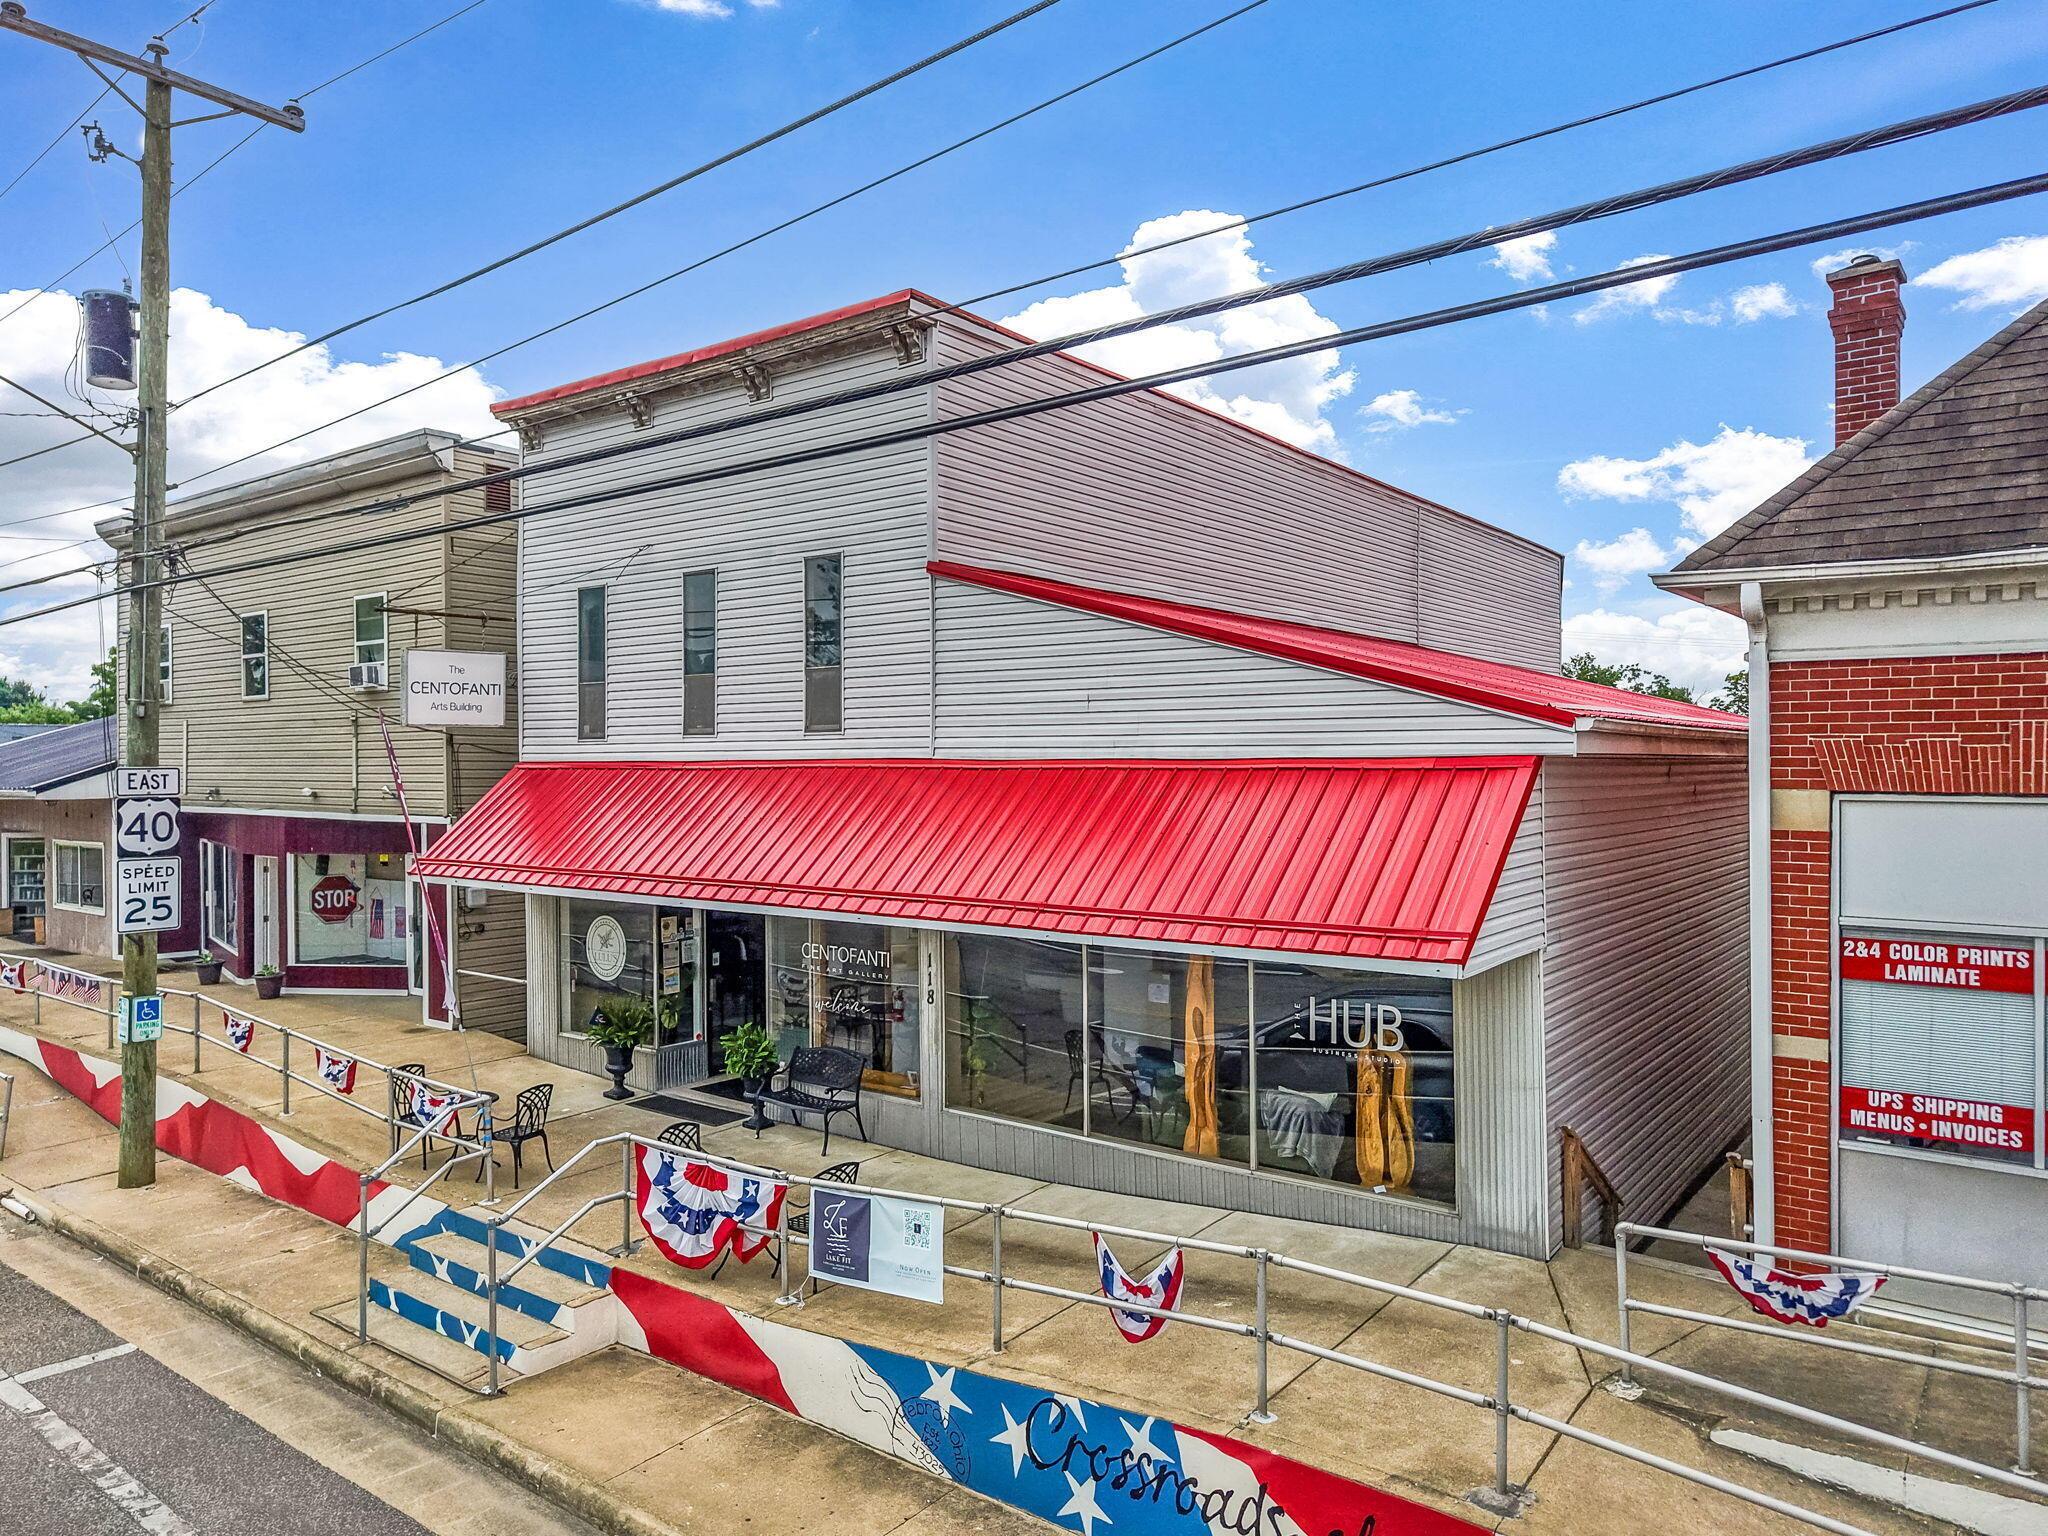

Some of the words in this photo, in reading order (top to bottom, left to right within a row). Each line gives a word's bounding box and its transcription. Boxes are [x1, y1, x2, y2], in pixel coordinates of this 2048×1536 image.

[449, 665, 466, 675] The
[410, 681, 501, 696] CENTOFANTI
[430, 702, 448, 711] Arts
[449, 702, 483, 713] Building
[127, 773, 169, 790] EAST
[124, 811, 174, 843] 40
[122, 866, 175, 879] SPEED
[128, 881, 169, 893] LIMIT
[314, 889, 356, 909] STOP
[124, 895, 173, 924] 25
[801, 942, 890, 968] CENTOFANTI
[1843, 940, 1881, 959] 2&4
[1889, 943, 1949, 963] COLOR
[1957, 948, 2030, 969] PRINTS
[801, 963, 821, 972] FINE
[826, 967, 843, 975] ART
[848, 969, 890, 980] GALLERY
[1884, 963, 1981, 987] LAMINATE
[815, 989, 871, 1014] welcome
[135, 1021, 160, 1030] PARKING
[1309, 996, 1404, 1052] HUB
[1312, 1047, 1358, 1059] BUSINESS
[1364, 1055, 1401, 1065] STUDIO
[1868, 1090, 1904, 1110] UPS
[1911, 1096, 2004, 1124] SHIPPING
[1850, 1108, 1915, 1133] MENUS
[1931, 1120, 2023, 1148] INVOICES
[911, 1440, 945, 1476] 43025
[949, 1431, 967, 1476] Ohio
[1025, 1397, 1298, 1536] Crossroads
